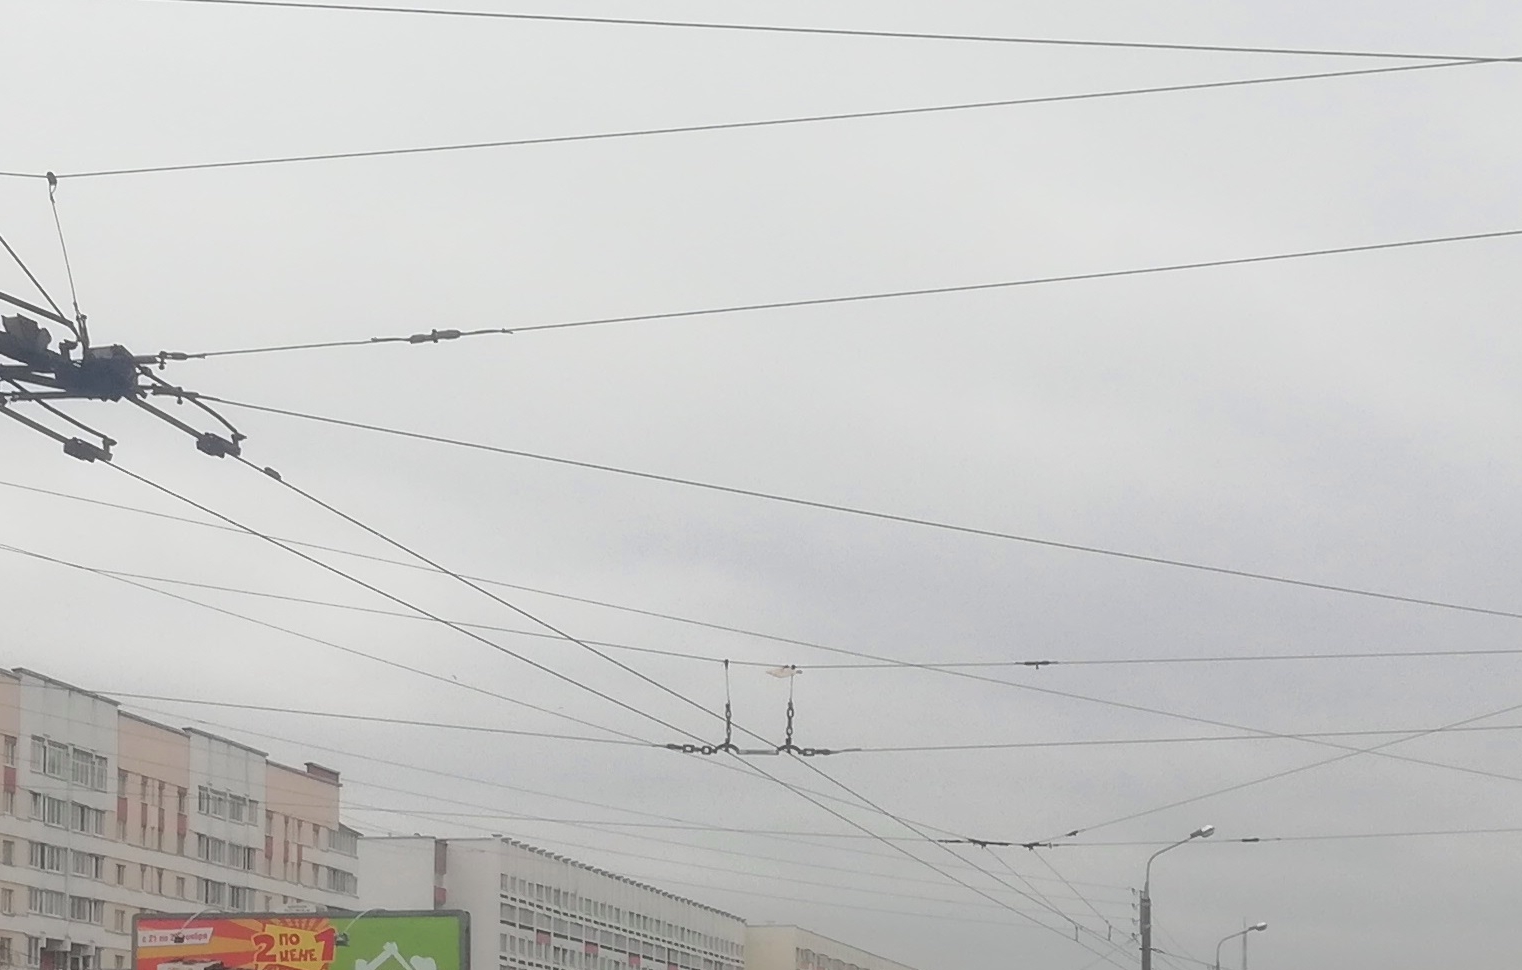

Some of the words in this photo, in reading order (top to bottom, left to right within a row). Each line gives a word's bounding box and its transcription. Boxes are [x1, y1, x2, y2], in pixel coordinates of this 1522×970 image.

[254, 934, 277, 962] 2
[279, 933, 300, 946] ПО
[314, 928, 336, 961] 1
[280, 949, 317, 962] ЦЕНЕ
